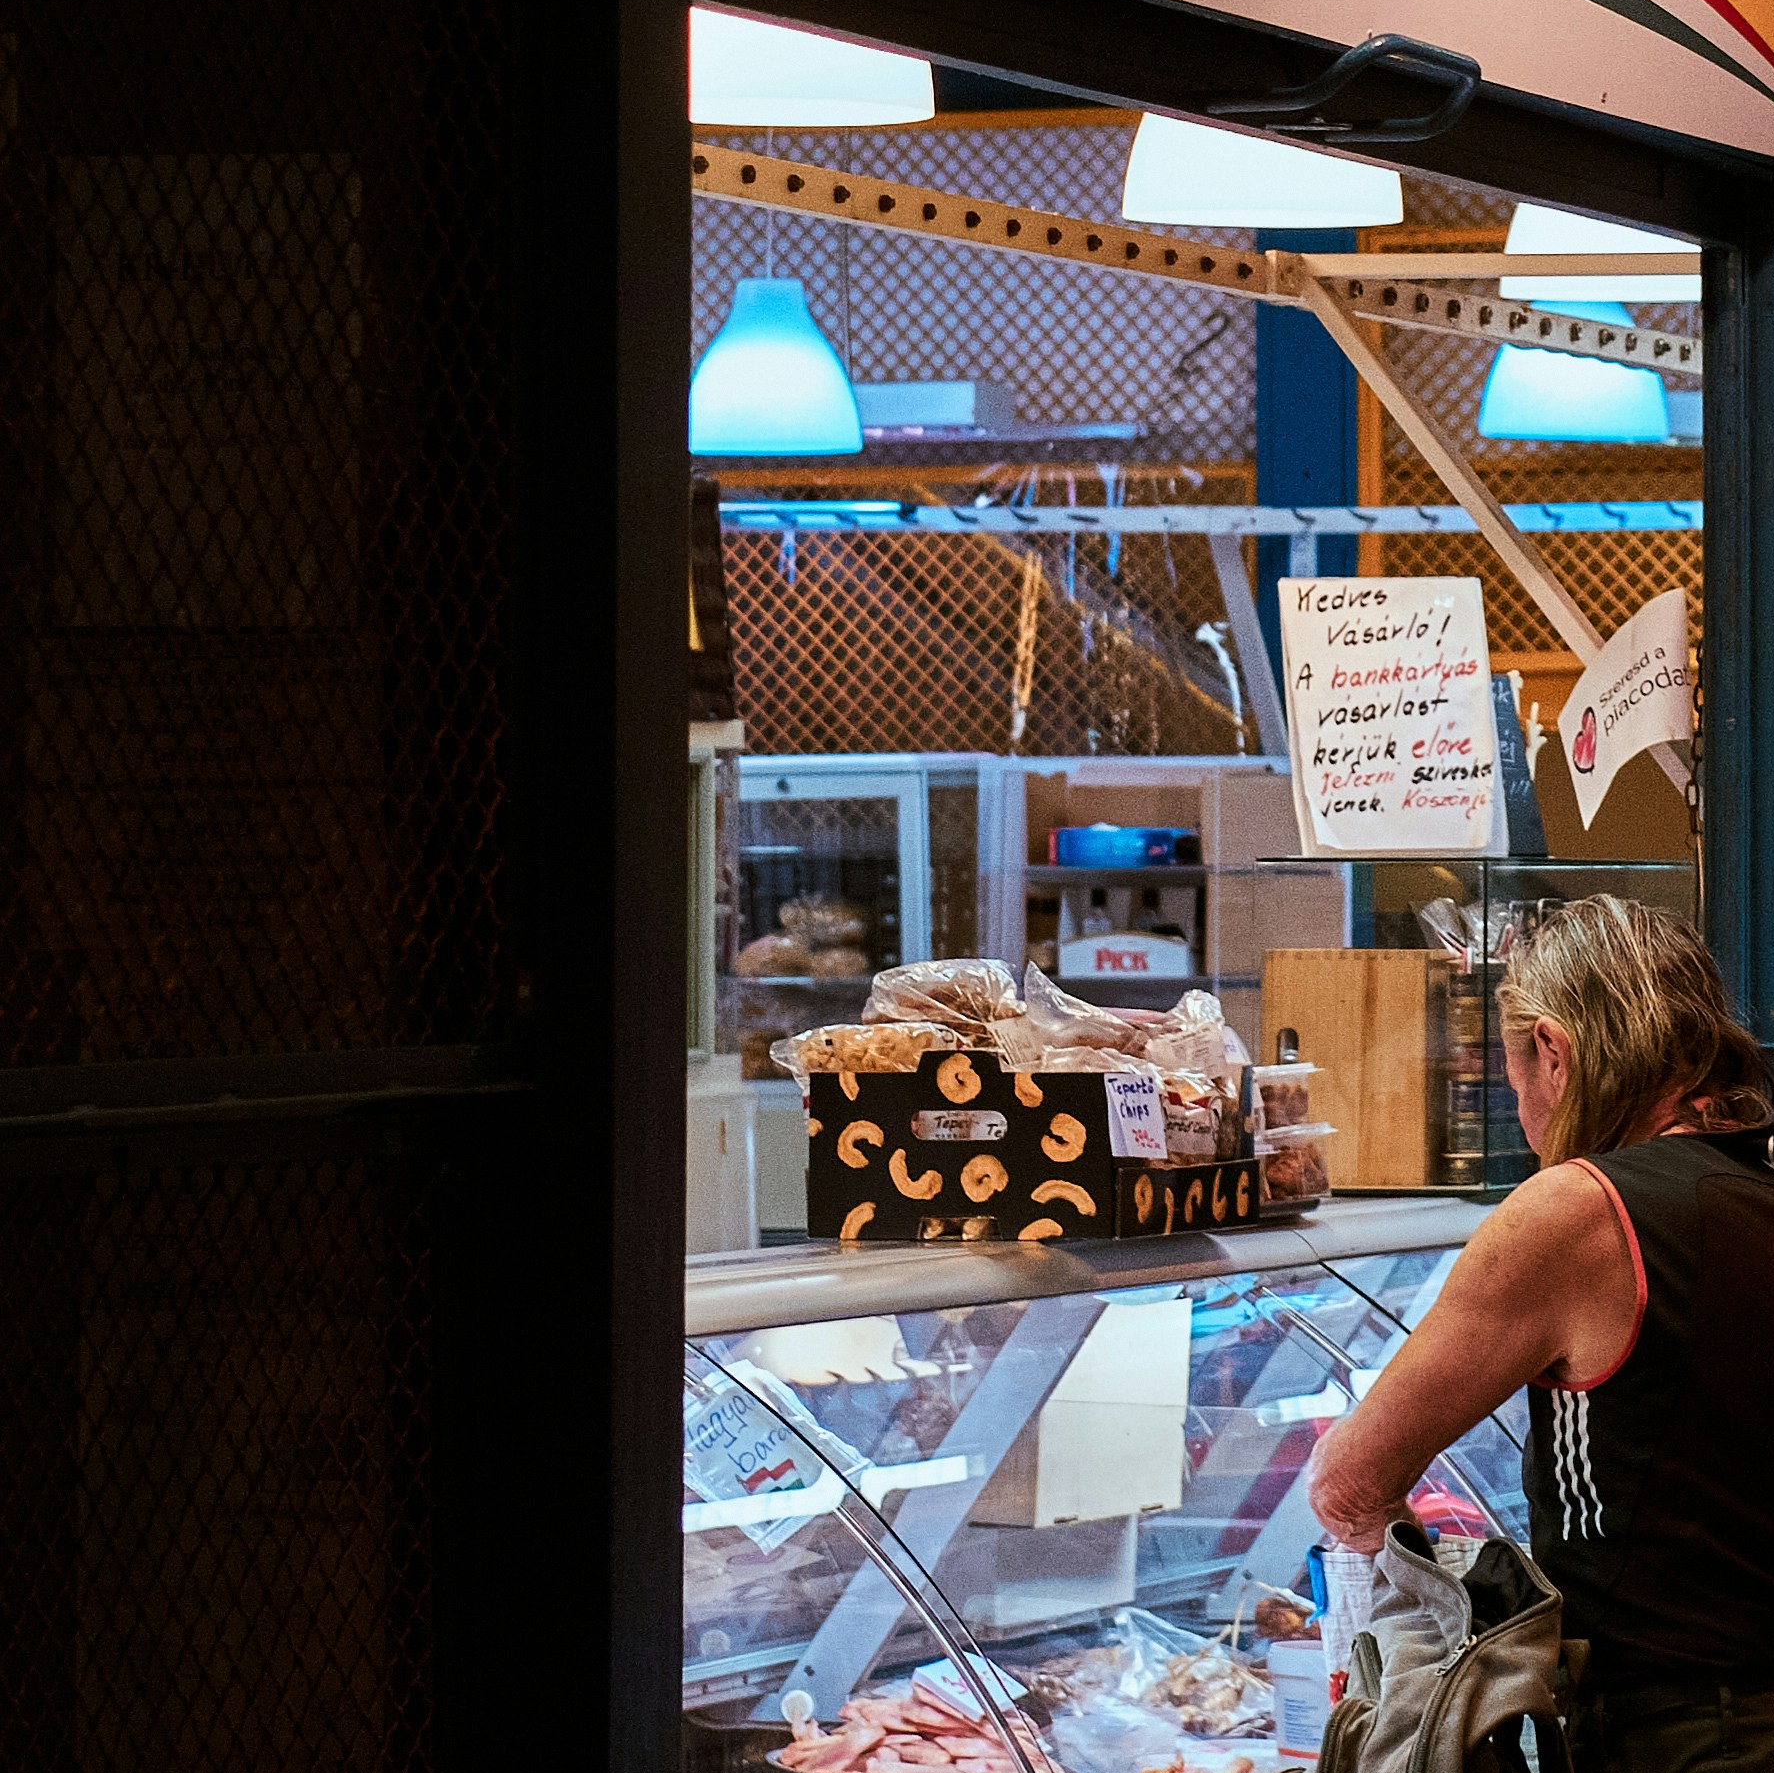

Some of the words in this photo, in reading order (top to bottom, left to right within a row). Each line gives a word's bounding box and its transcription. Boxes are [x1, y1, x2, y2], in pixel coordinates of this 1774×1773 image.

[1296, 583, 1388, 613] Kedves
[1294, 663, 1314, 691] A
[1330, 646, 1479, 696] bankkártyás
[1599, 651, 1650, 709] szeresd
[1654, 646, 1666, 660] a
[1317, 686, 1450, 728] vásárlást
[1602, 664, 1692, 737] piacodat
[1313, 732, 1398, 774] kérjük
[1410, 722, 1473, 759] előre
